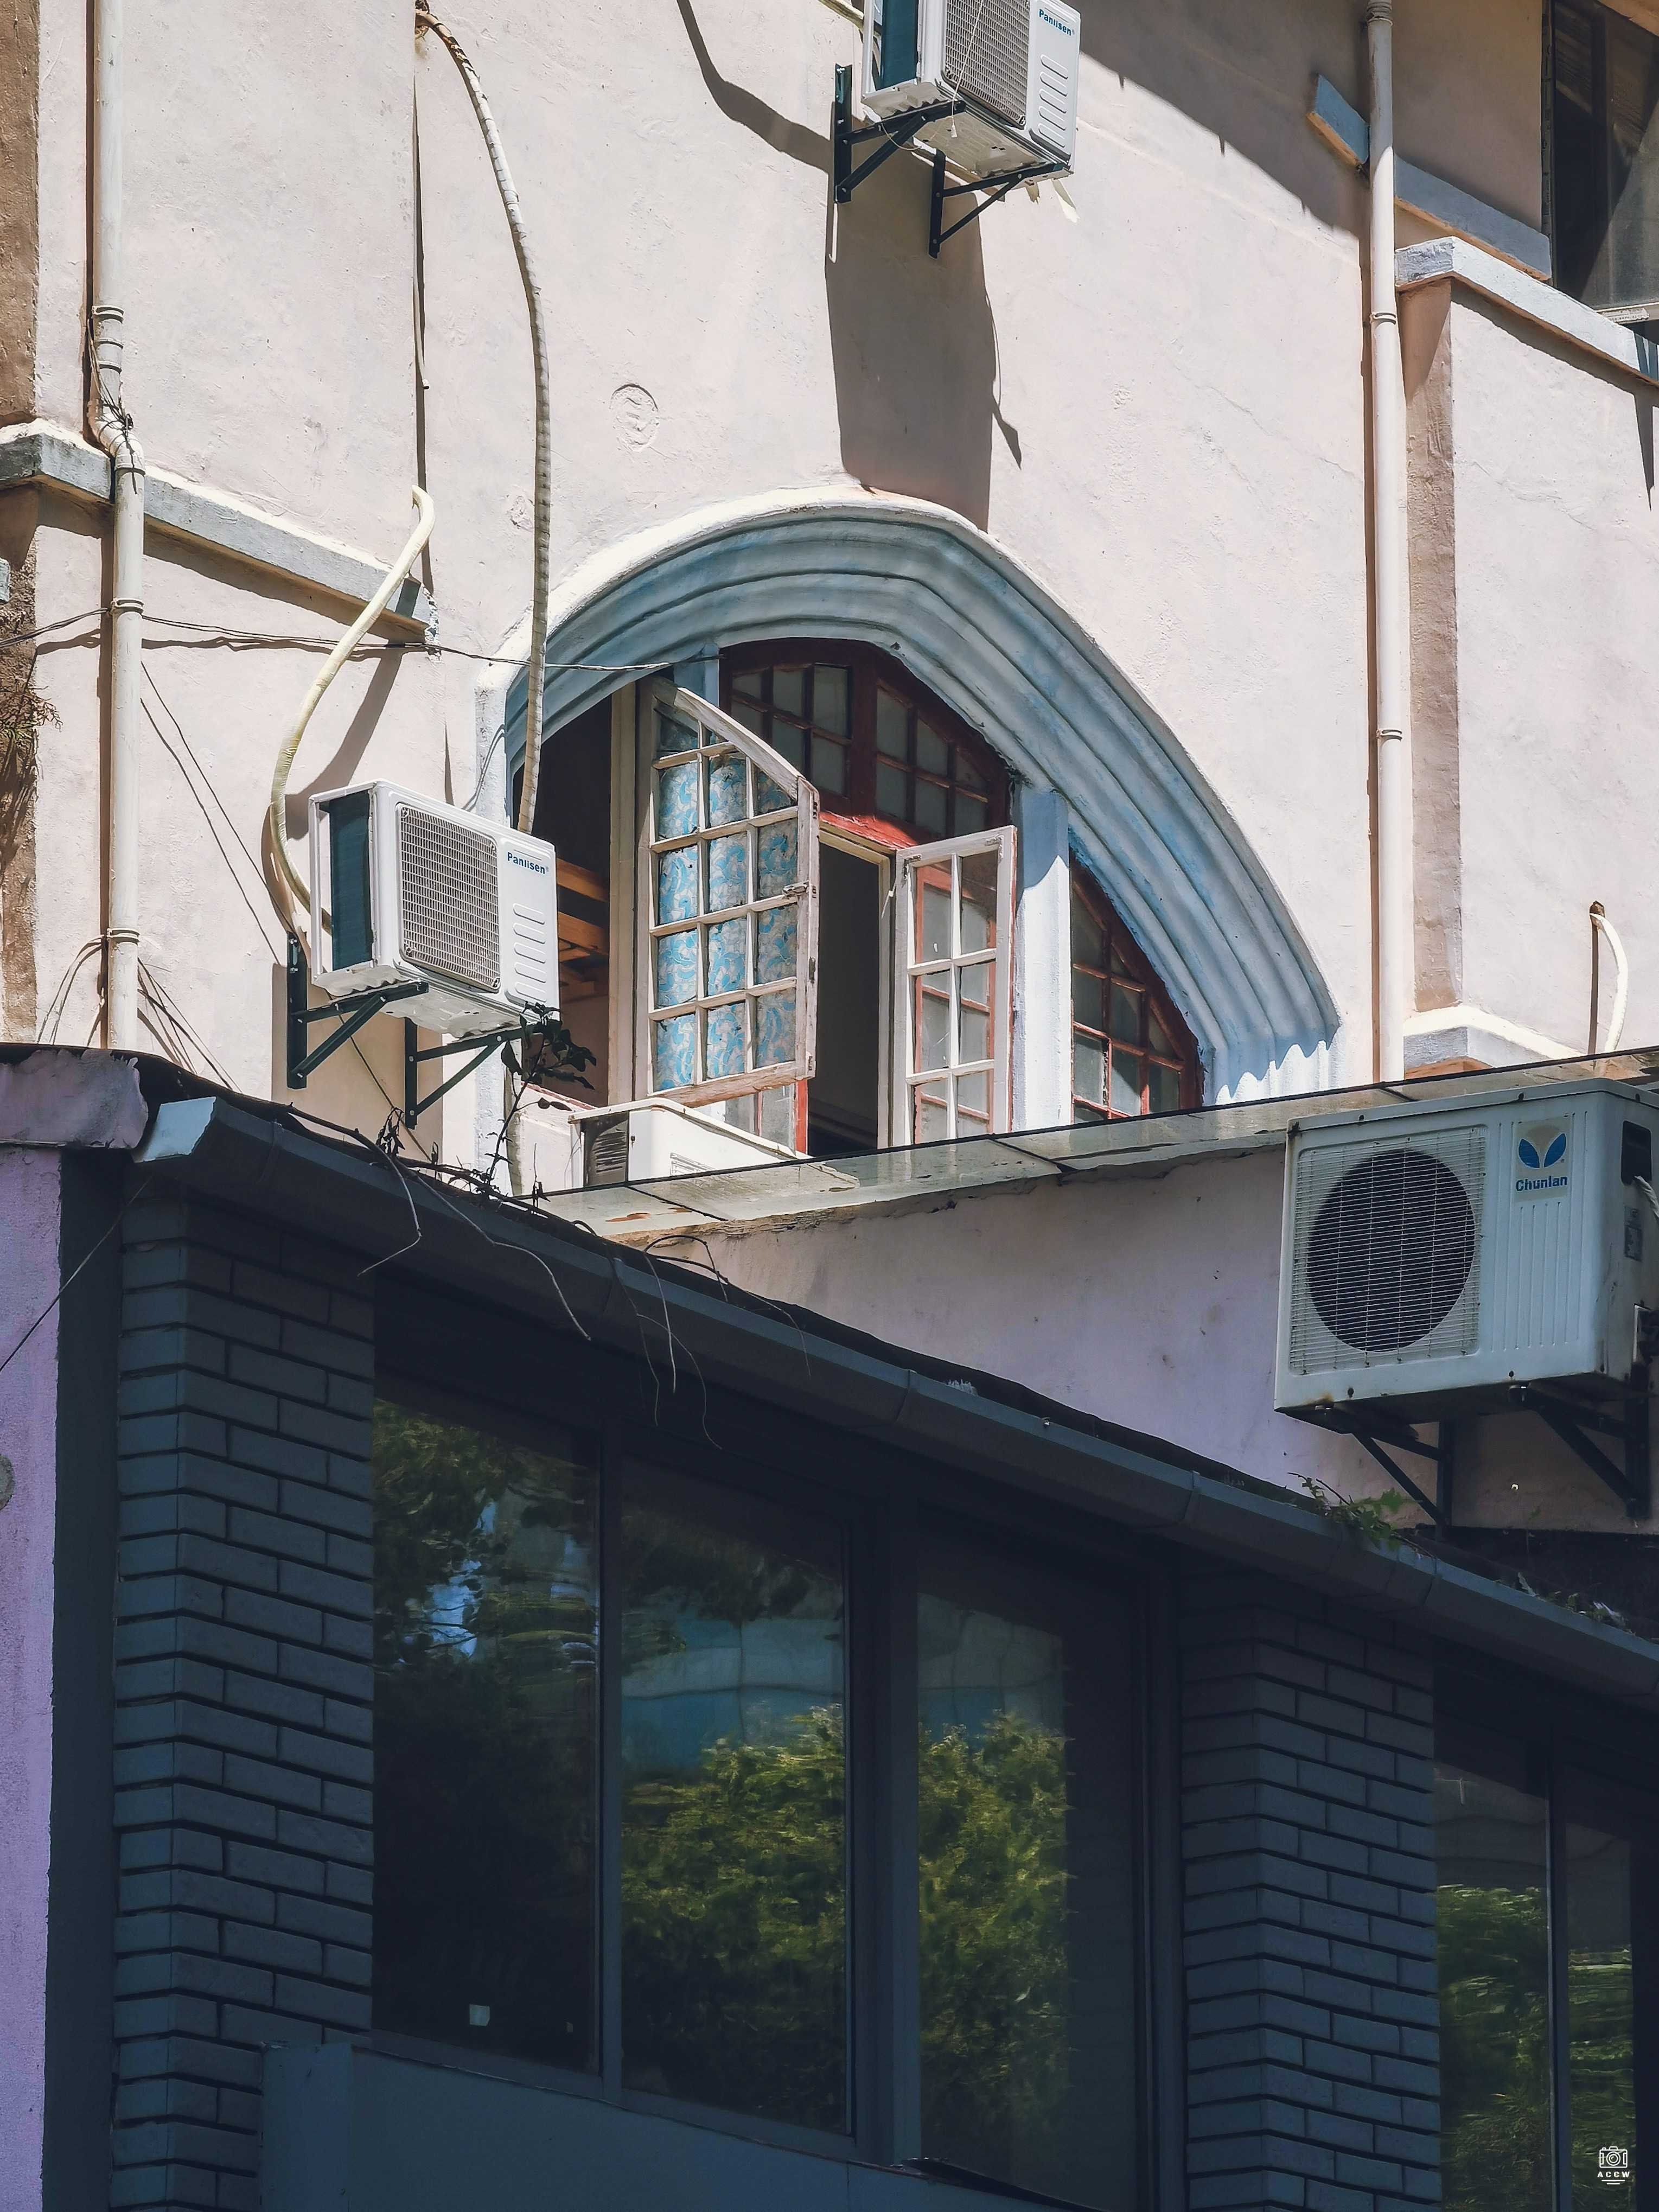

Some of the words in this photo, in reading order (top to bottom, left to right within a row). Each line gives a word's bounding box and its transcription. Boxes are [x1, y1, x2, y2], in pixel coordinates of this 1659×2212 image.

[1039, 8, 1071, 36] Panlisen
[507, 852, 545, 874] Panlisen
[1516, 1176, 1568, 1191] Chunlan
